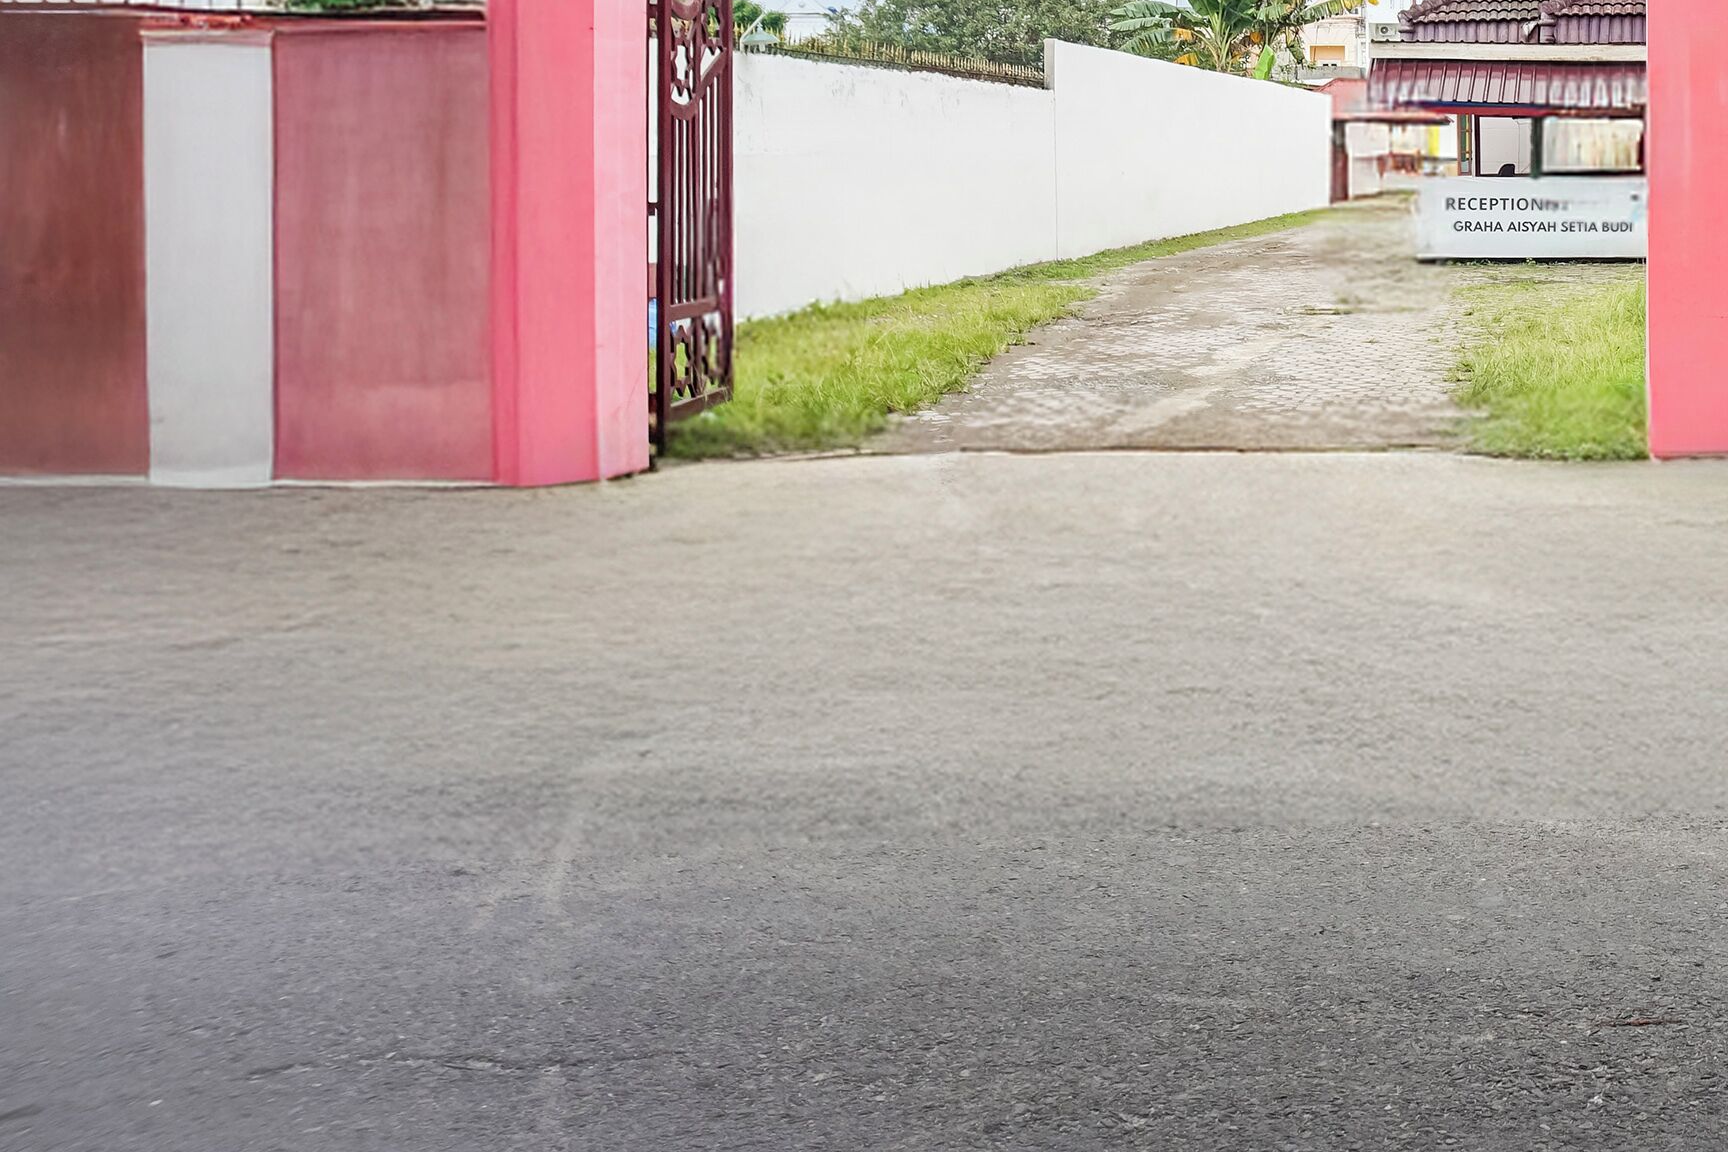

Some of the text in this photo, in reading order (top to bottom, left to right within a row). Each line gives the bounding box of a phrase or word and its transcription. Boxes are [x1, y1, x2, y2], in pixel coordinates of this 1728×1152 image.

[1453, 220, 1633, 232] GRAHA AISYAH SETIA BUDI
